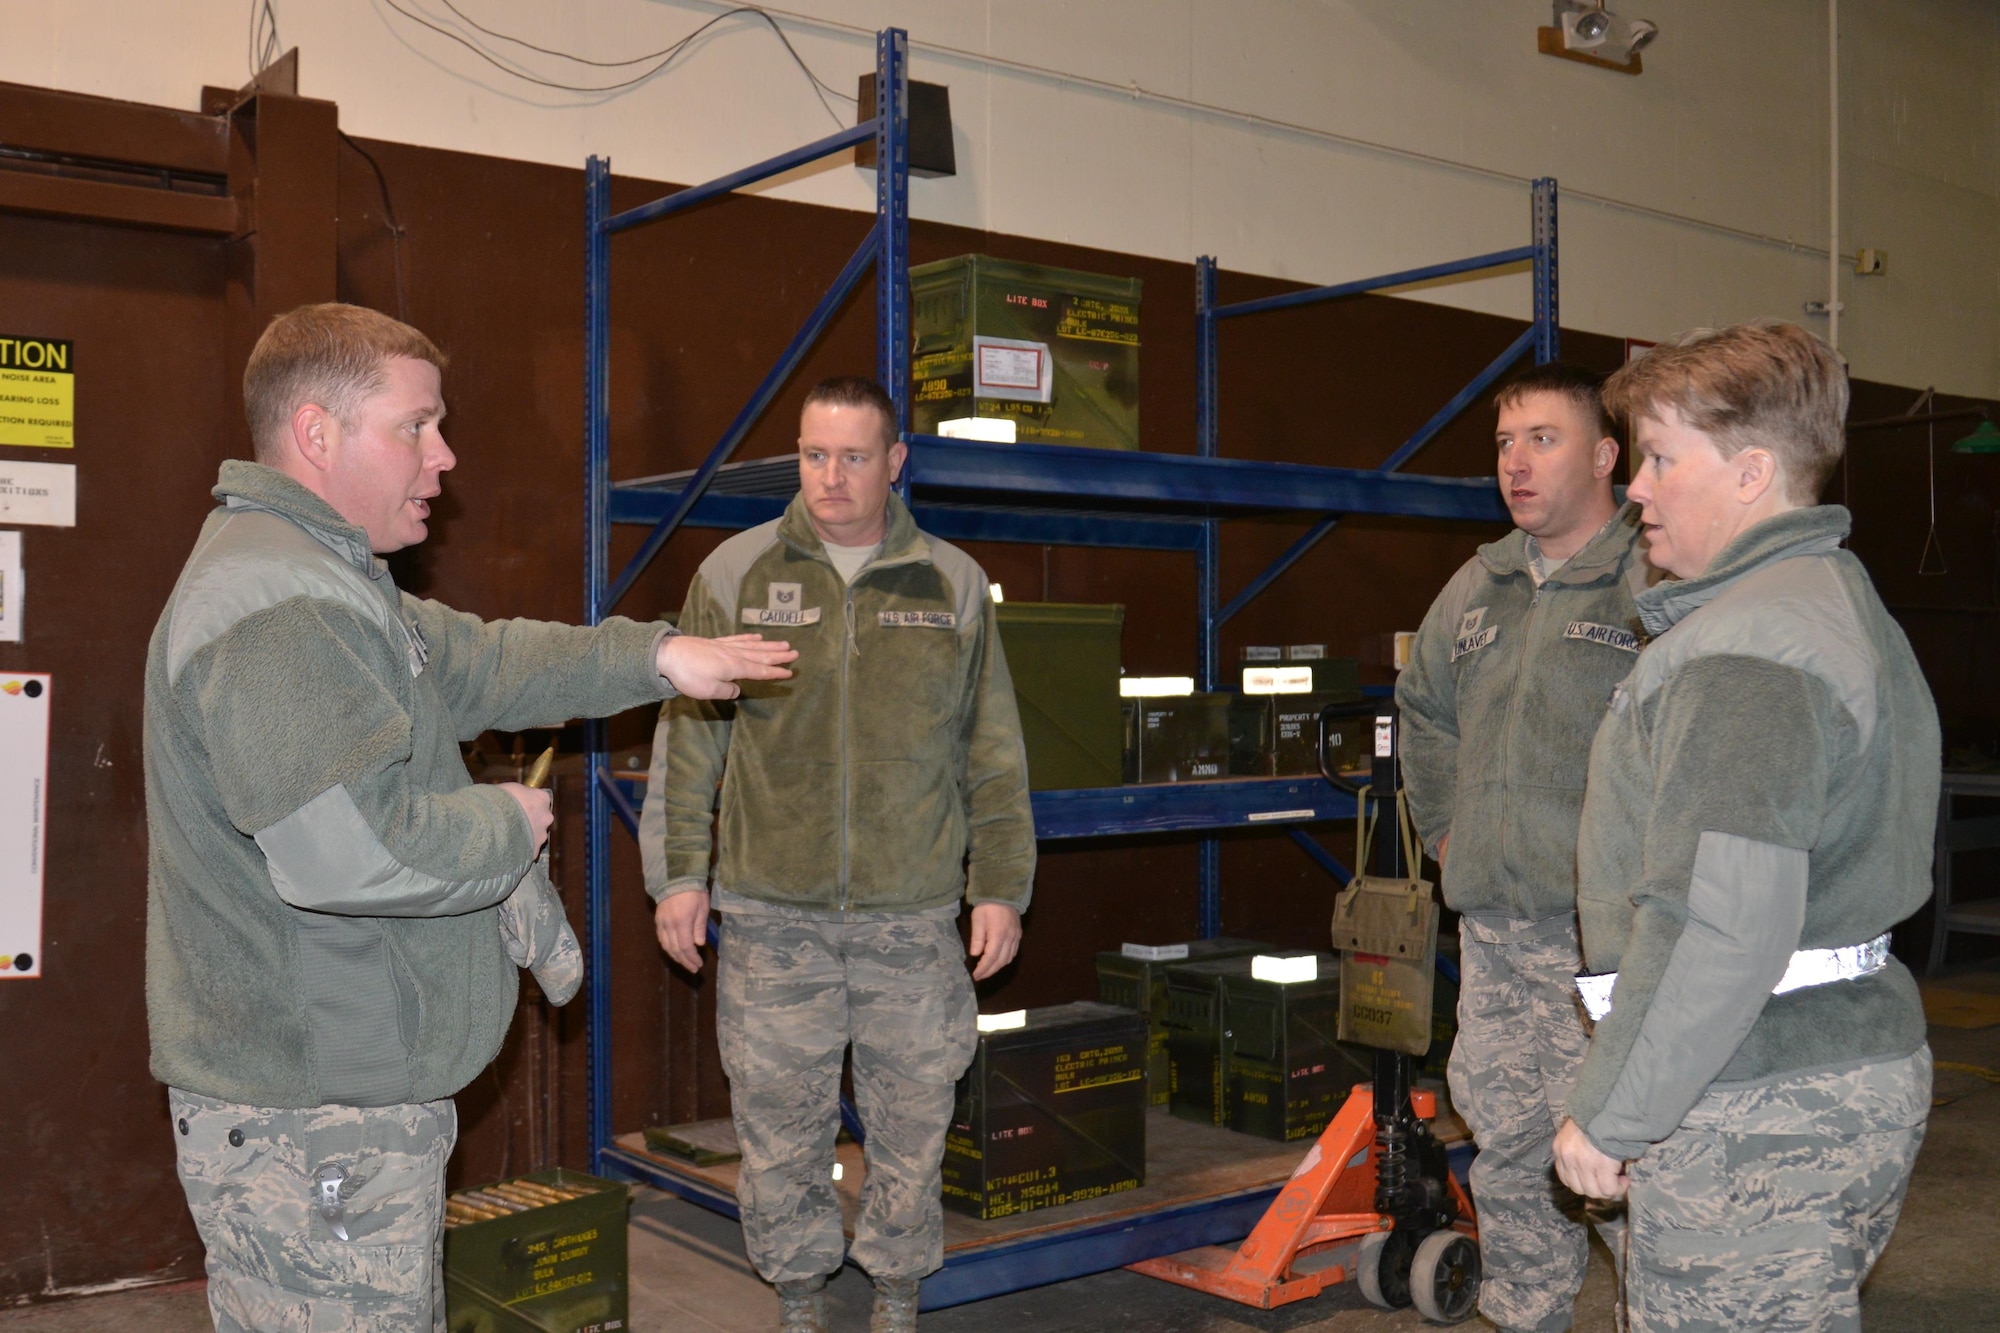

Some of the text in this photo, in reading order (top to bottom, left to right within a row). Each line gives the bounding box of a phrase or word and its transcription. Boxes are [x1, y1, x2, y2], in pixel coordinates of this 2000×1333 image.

[1006, 294, 1048, 308] LITE BOX
[2, 373, 56, 383] NOISE AREA
[37, 397, 60, 405] LOSS
[28, 418, 72, 427] REQUIRED
[760, 610, 807, 624] CAUDELL
[904, 613, 919, 623] AIR
[922, 613, 952, 625] FORCE
[1586, 626, 1607, 640] AIR
[1279, 713, 1310, 722] PROPERTY
[1192, 763, 1218, 775] AMMO
[991, 1125, 1034, 1140] LITE BOX
[553, 1228, 599, 1248] CARTRIDGES
[560, 1245, 590, 1261] DUMMY
[533, 1267, 556, 1280] BULK
